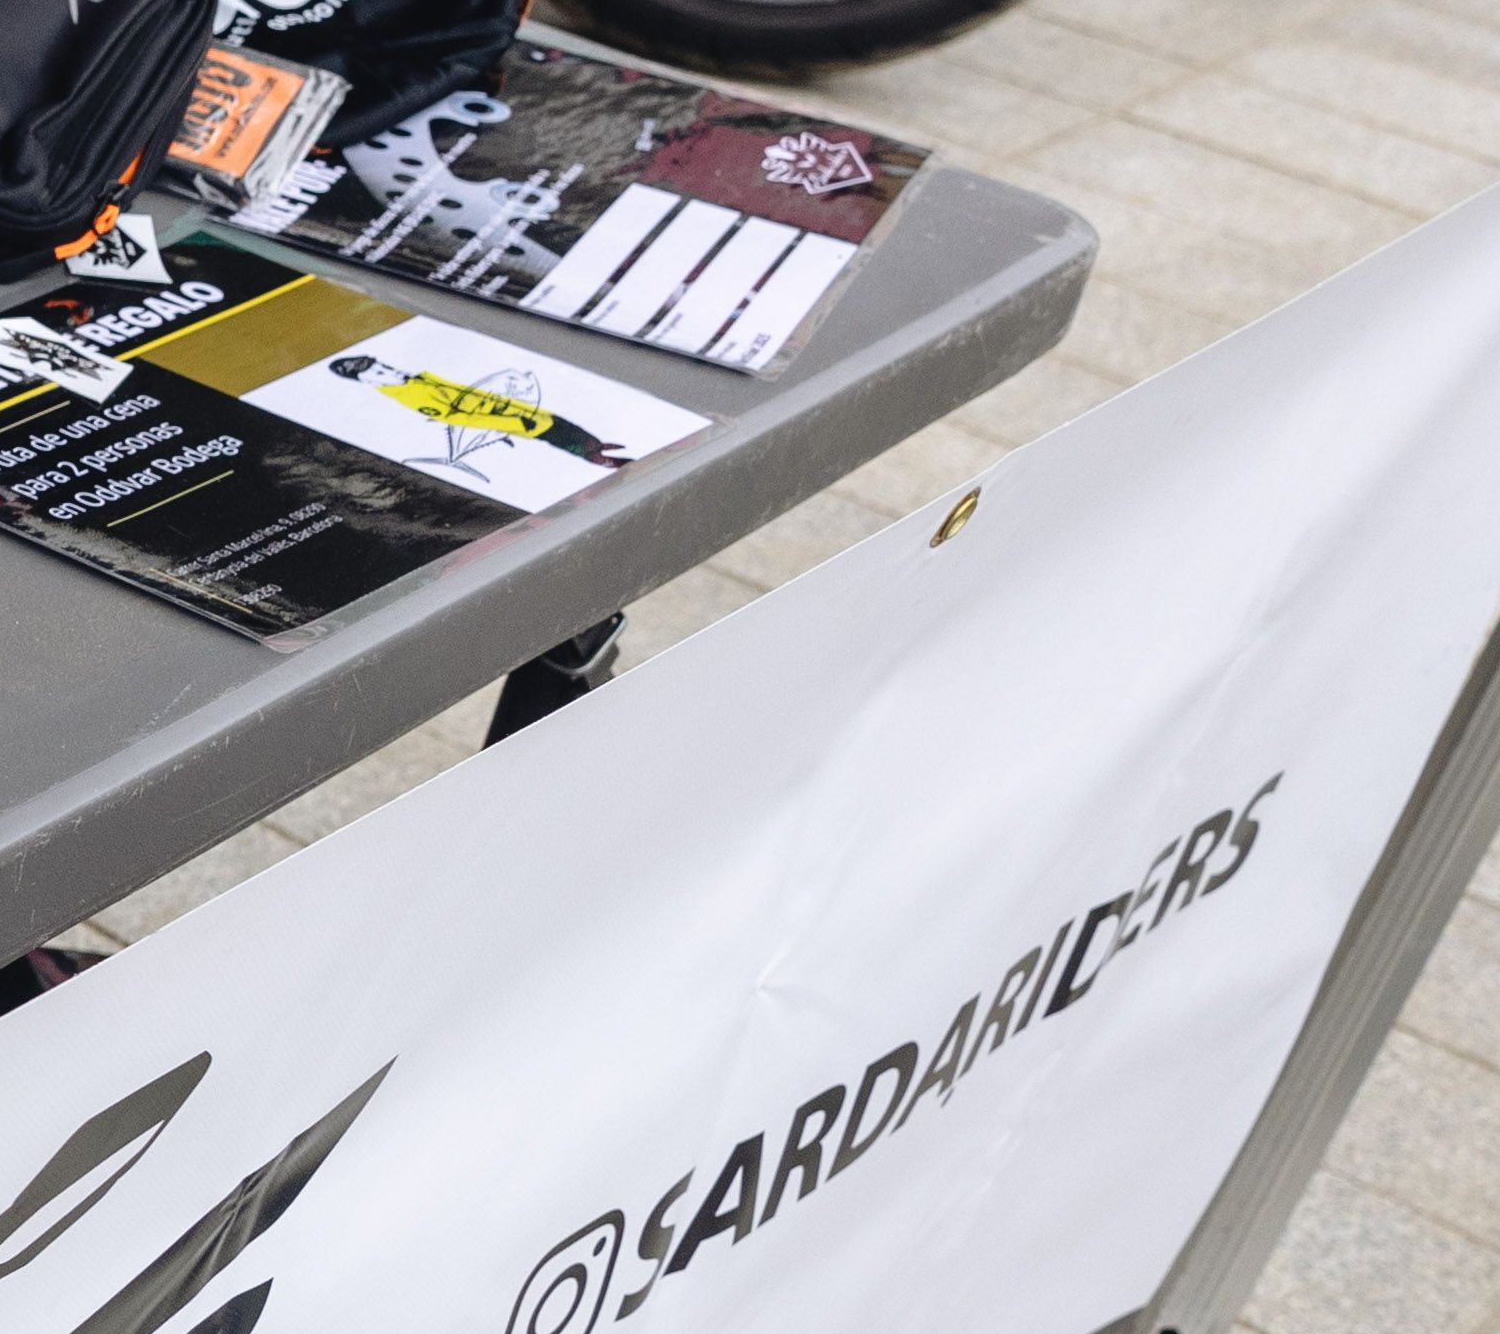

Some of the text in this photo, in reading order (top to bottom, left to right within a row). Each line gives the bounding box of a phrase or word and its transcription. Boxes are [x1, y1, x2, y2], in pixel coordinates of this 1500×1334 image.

[98, 280, 226, 353] REGALO
[10, 420, 185, 503] para 2 personas
[30, 424, 61, 453] de
[63, 411, 106, 441] una
[105, 392, 162, 424] cena
[47, 433, 246, 523] en Oddvar Bodega
[614, 768, 1286, 1323] SARDARIDERS
